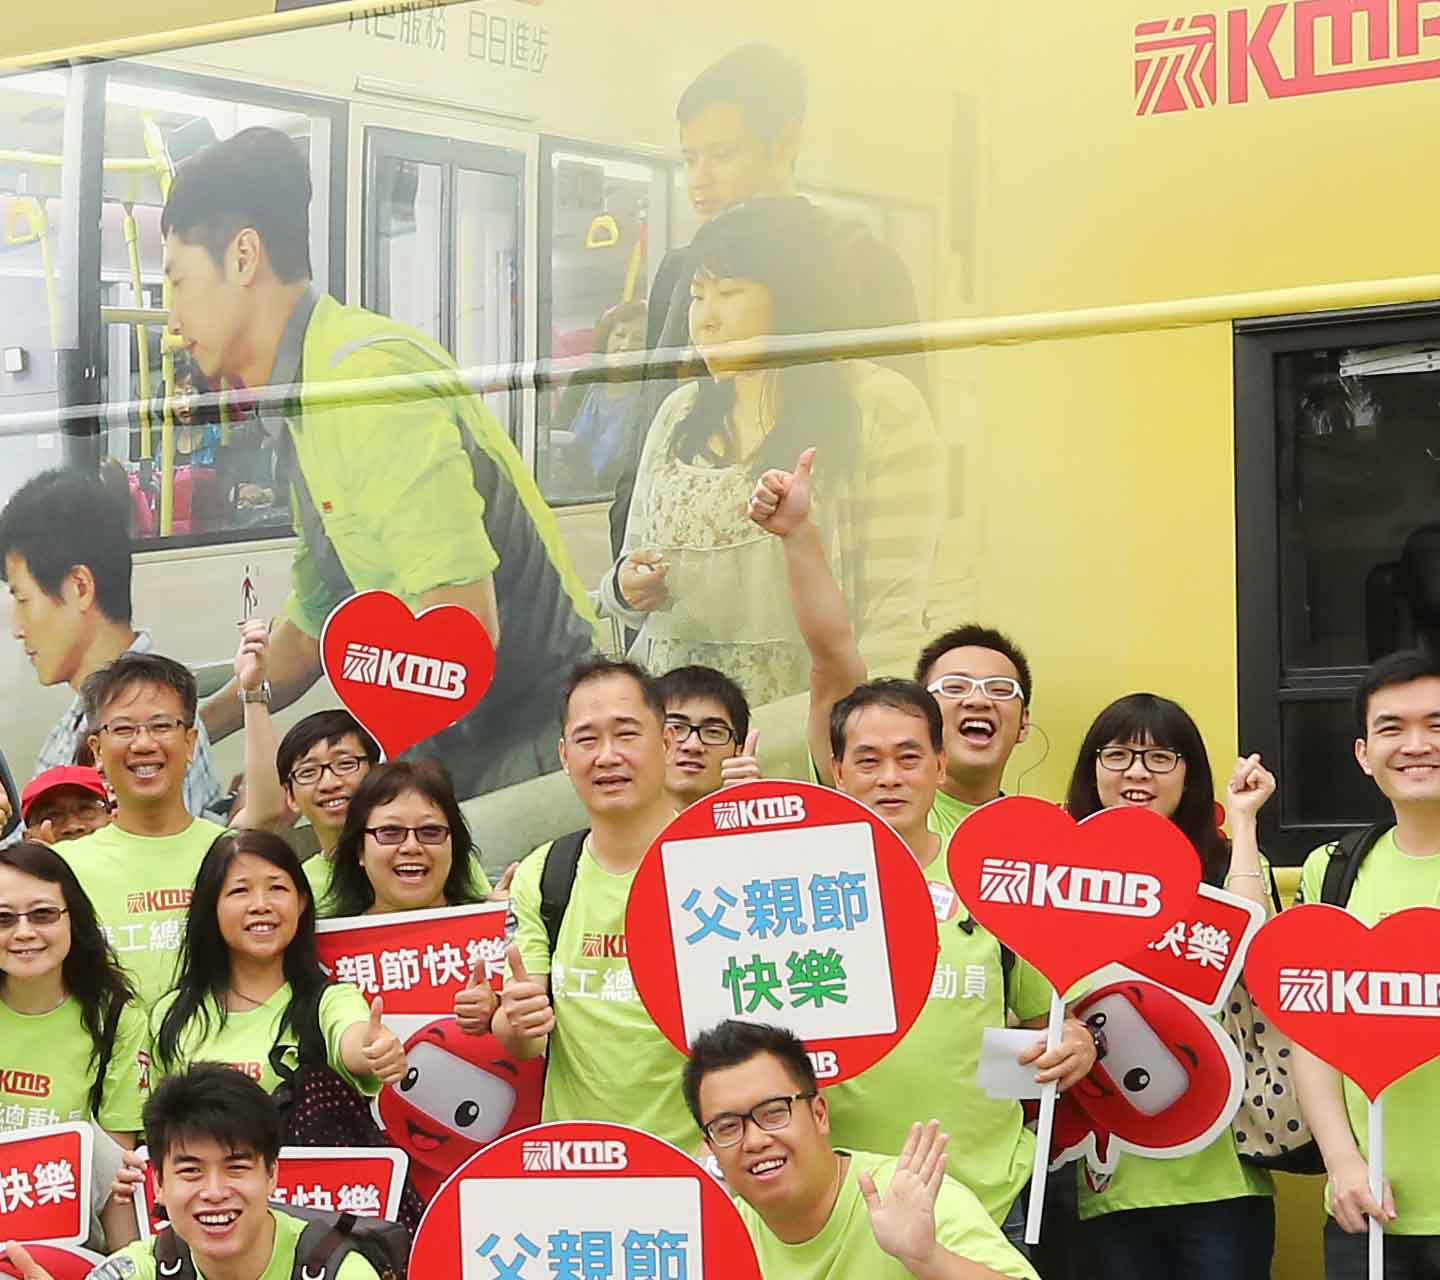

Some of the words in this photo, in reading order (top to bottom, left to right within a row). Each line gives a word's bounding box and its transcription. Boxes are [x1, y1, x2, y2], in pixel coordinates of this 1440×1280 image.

[375, 650, 468, 700] KMB
[737, 792, 806, 826] KMB
[681, 869, 870, 946] 父親節
[1030, 862, 1163, 918] KMB
[721, 944, 848, 1016] 快樂
[552, 1141, 628, 1171] KMB
